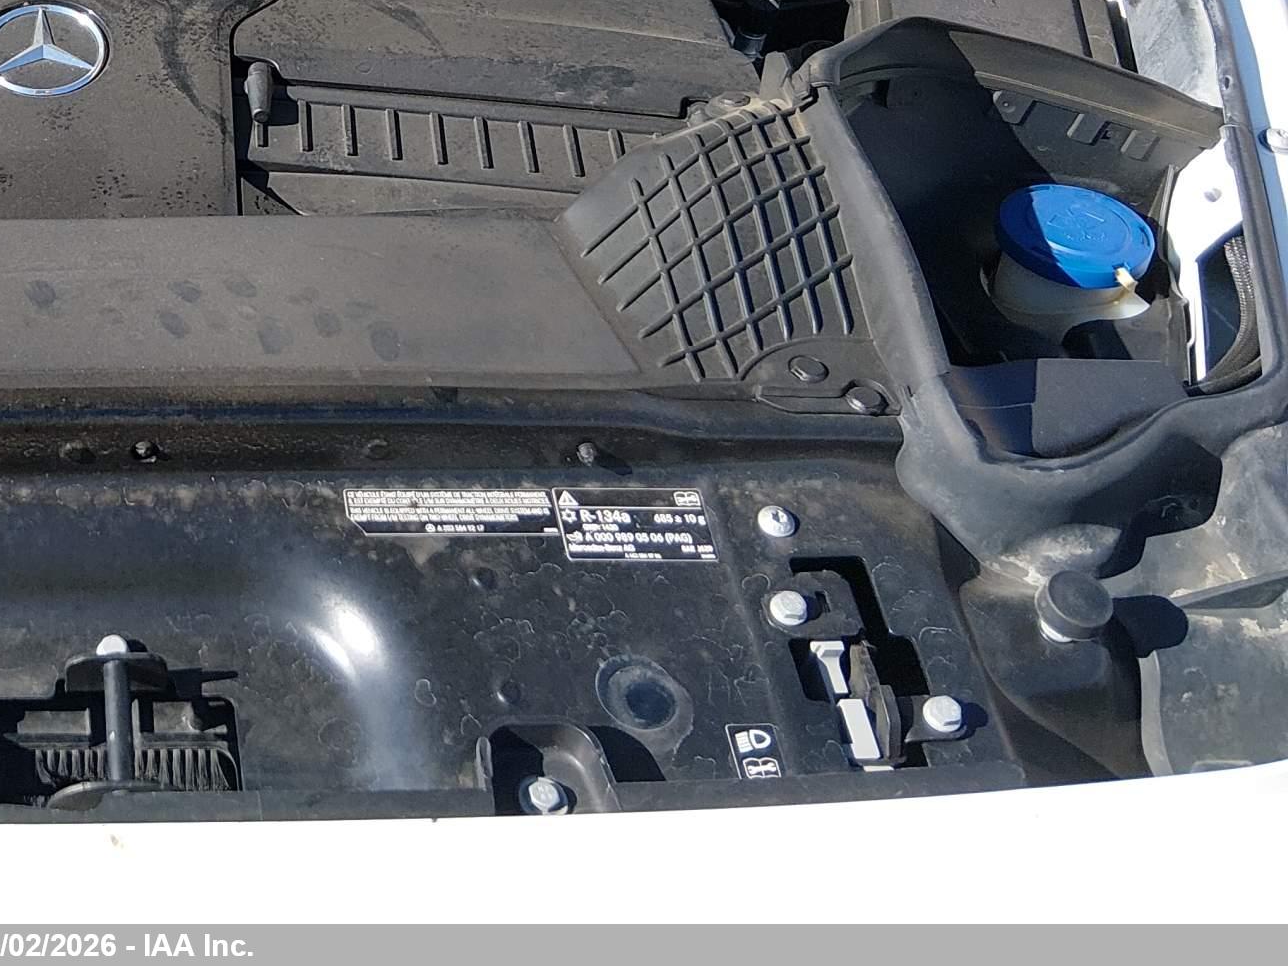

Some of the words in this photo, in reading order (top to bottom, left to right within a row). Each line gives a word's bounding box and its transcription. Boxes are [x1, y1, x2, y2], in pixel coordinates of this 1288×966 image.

[579, 509, 631, 523] R-134a
[684, 513, 697, 524] 10
[697, 515, 706, 526] g
[585, 533, 594, 542] A
[594, 533, 614, 542] 000
[665, 533, 693, 545] (PAG)
